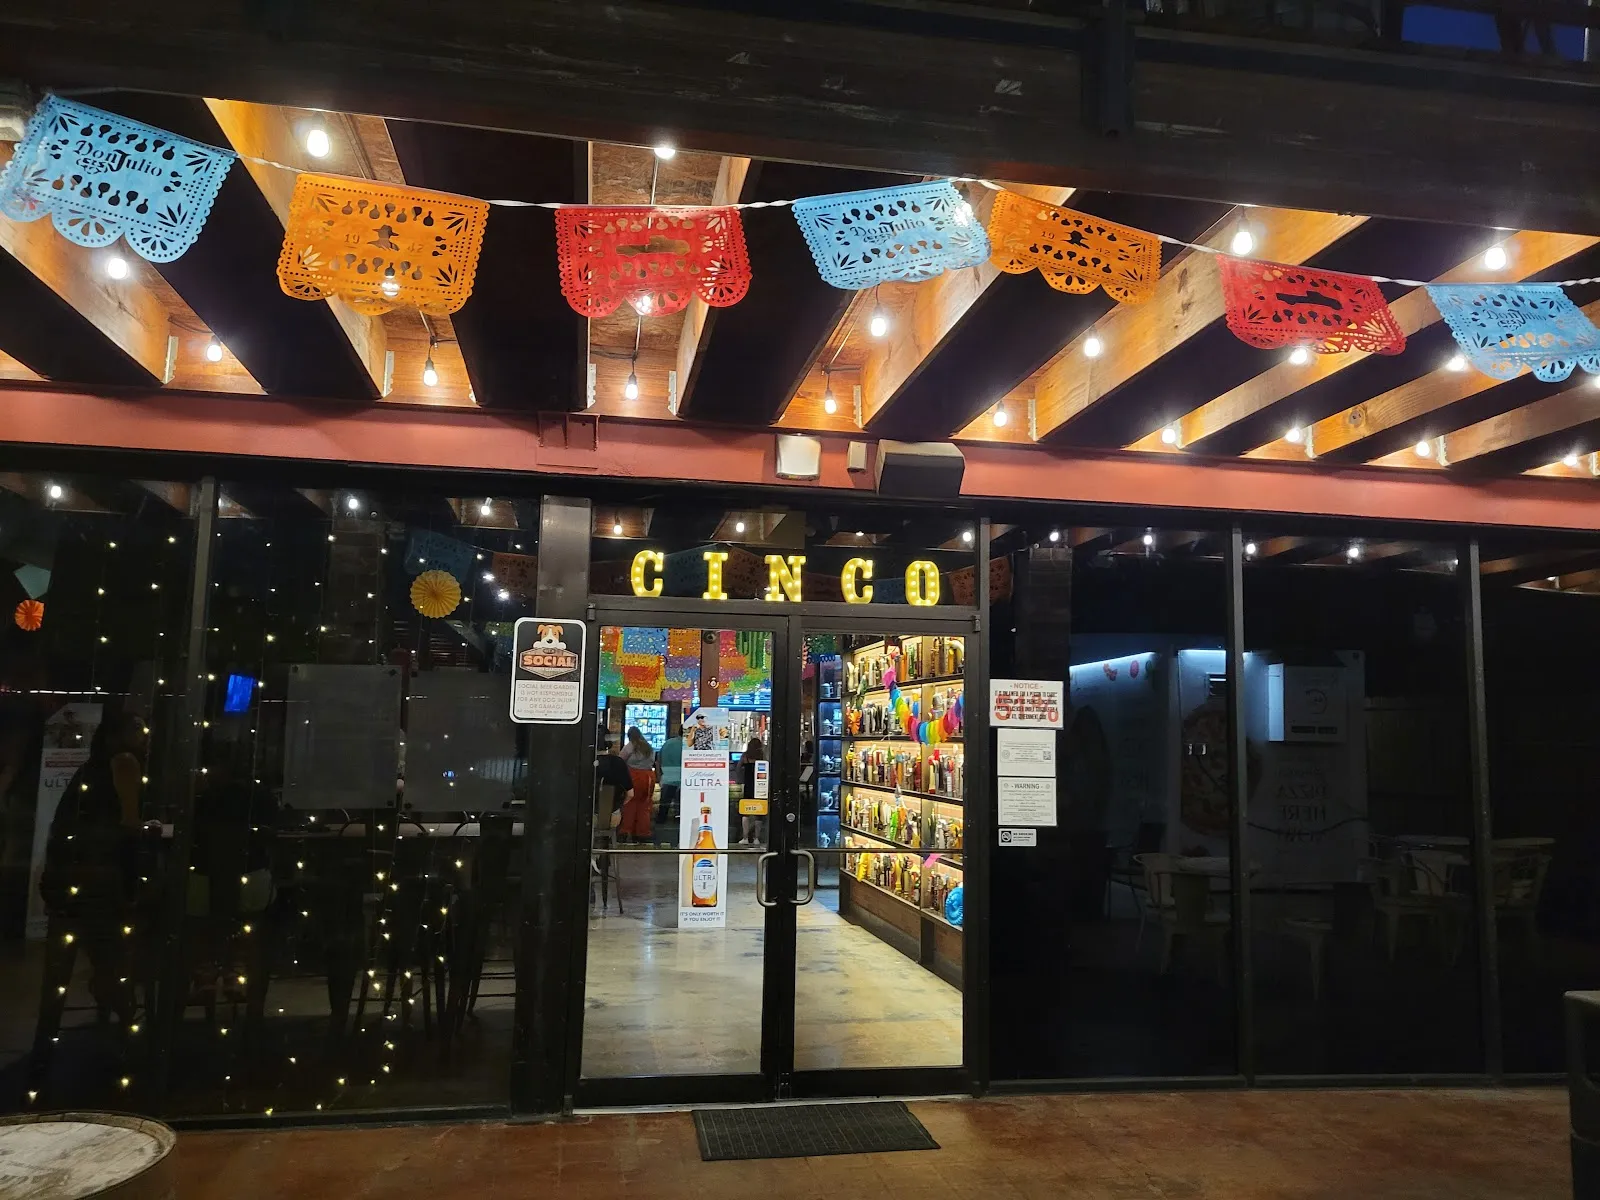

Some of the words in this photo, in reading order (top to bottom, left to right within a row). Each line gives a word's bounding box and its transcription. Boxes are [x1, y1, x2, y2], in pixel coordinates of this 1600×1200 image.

[73, 140, 118, 164] Don
[108, 149, 163, 177] Julio
[849, 221, 889, 237] Don
[879, 218, 925, 237] Julio
[344, 233, 361, 245] 19
[630, 550, 941, 607] CINCO
[523, 655, 575, 668] SOCIAL
[44, 778, 71, 788] ULT
[685, 778, 723, 787] ULTRA
